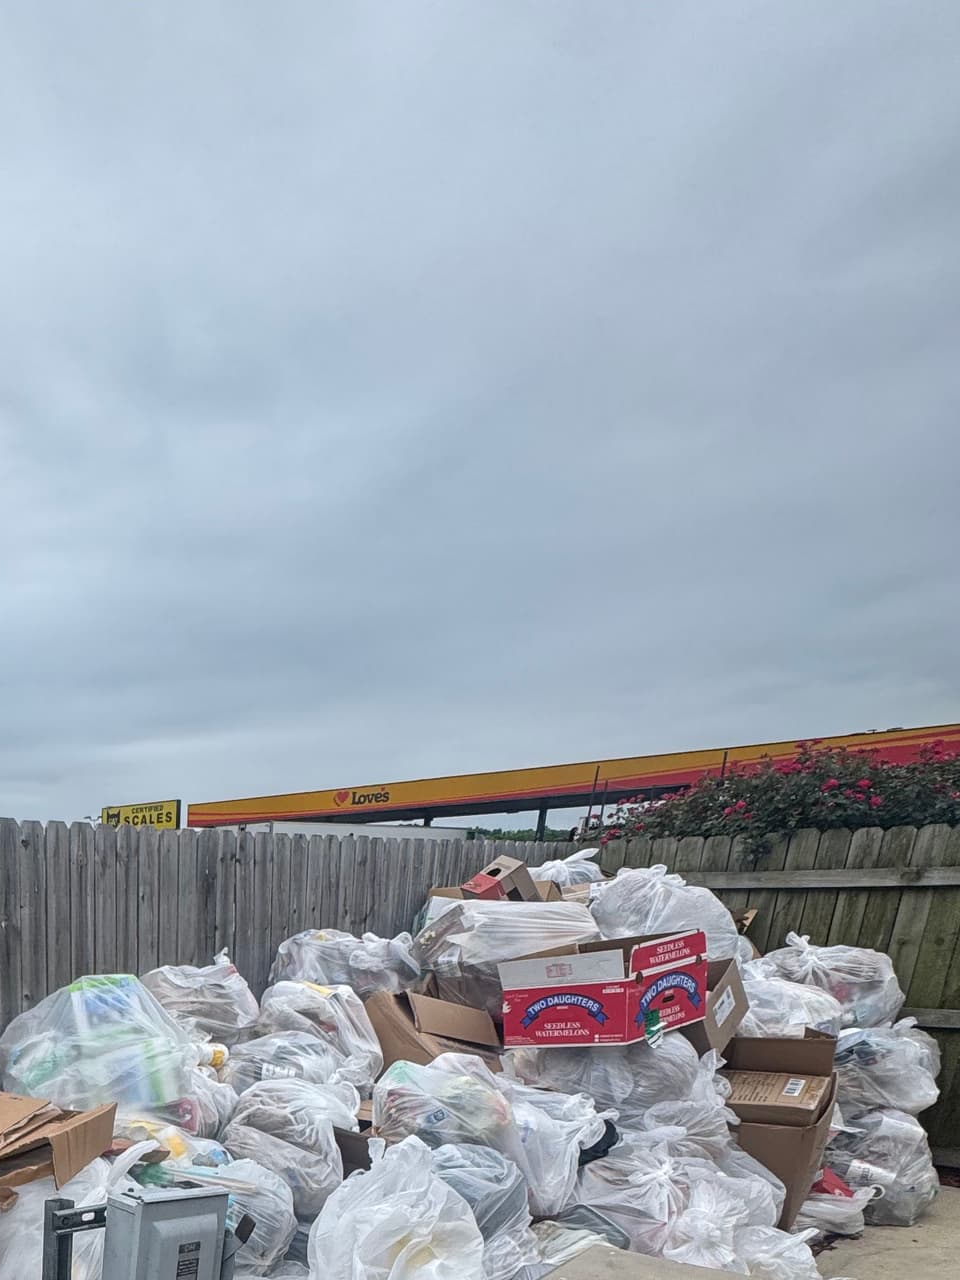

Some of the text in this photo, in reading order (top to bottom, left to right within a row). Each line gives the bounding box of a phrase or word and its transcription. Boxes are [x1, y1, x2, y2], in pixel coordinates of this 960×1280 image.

[351, 787, 390, 805] Love's
[131, 805, 164, 814] CERTIFIED
[124, 811, 173, 826] SCALES
[657, 940, 685, 954] SEEDLESS
[649, 947, 691, 964] WATERMELONS
[641, 987, 658, 1007] TWO
[657, 974, 696, 993] DAUGHTERS
[528, 995, 600, 1015] TWO DAUGHTERS
[535, 1029, 590, 1037] WATERMELONS
[544, 1022, 581, 1030] SEEDLESS
